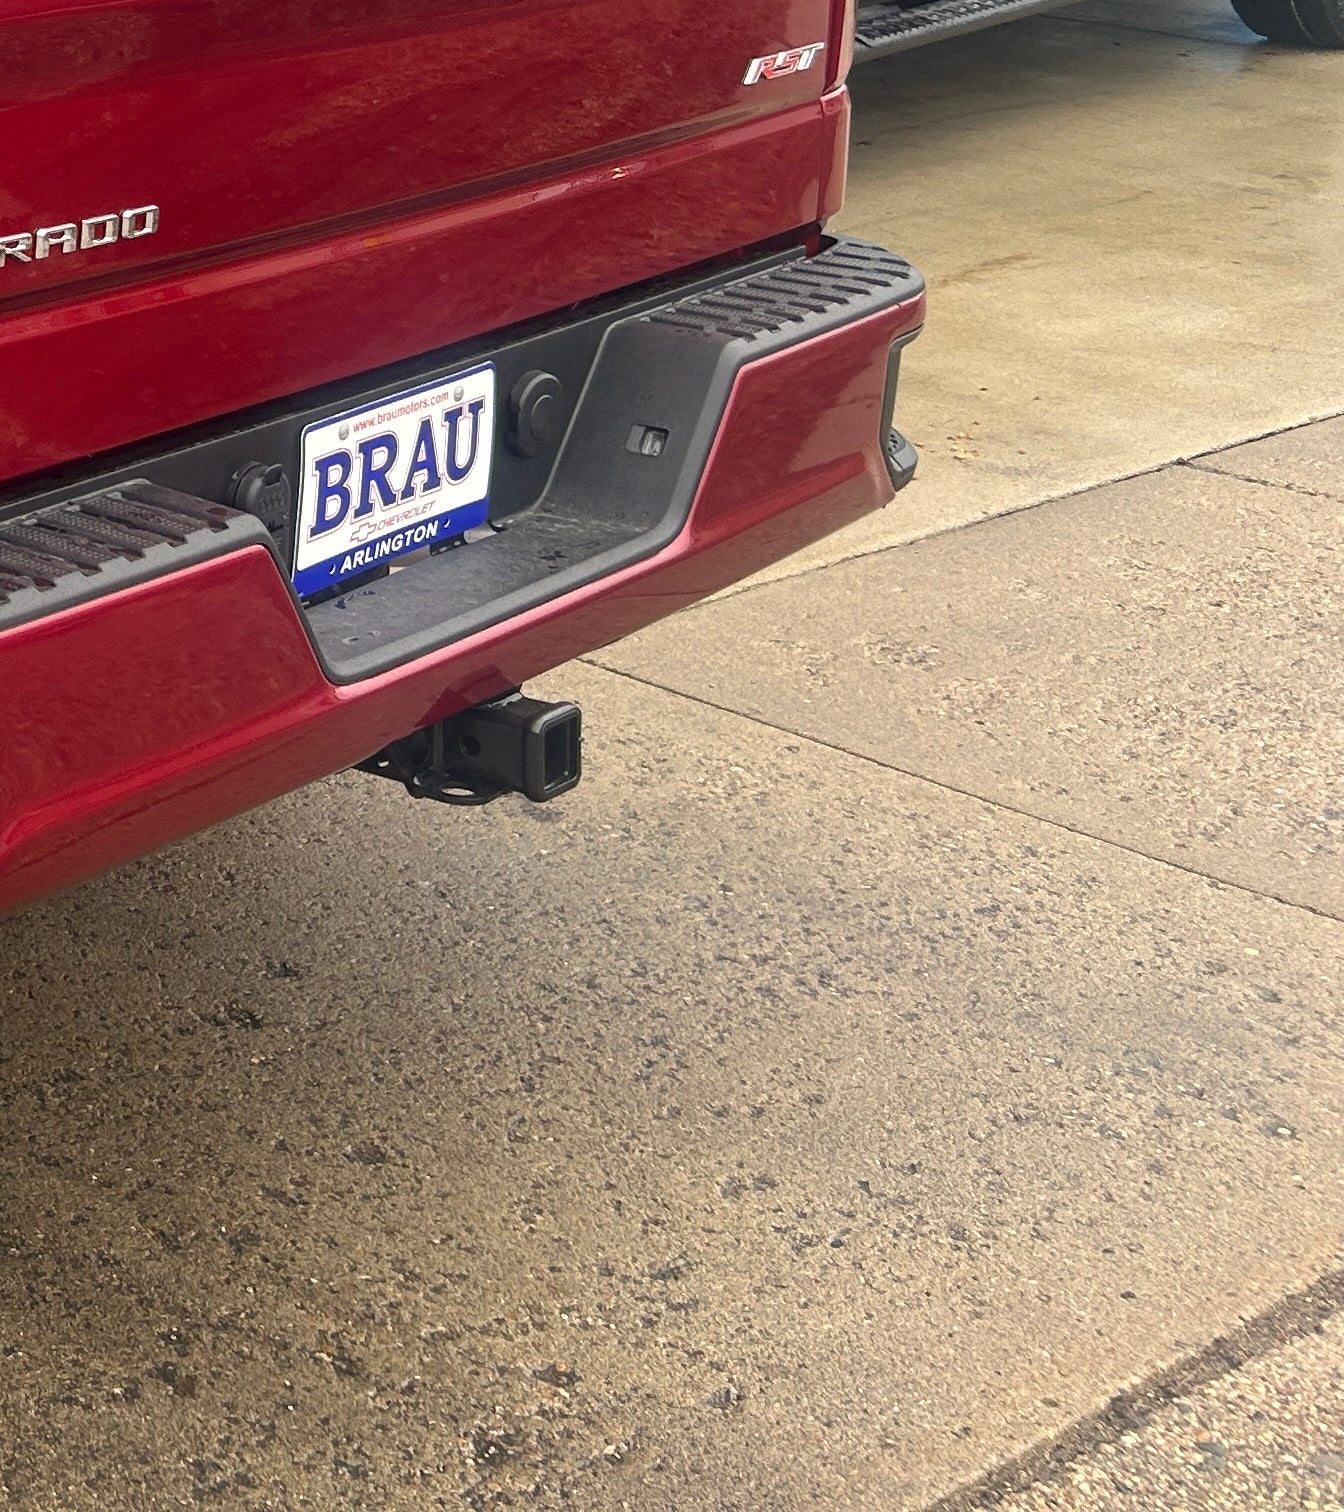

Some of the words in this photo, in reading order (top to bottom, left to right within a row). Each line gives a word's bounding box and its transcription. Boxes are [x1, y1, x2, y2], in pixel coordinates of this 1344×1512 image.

[742, 41, 825, 85] RST
[352, 391, 449, 433] www.braumotors.com
[306, 394, 486, 544] BRAU
[376, 500, 436, 530] CHEVROLET
[339, 519, 439, 574] ARLINGTON
